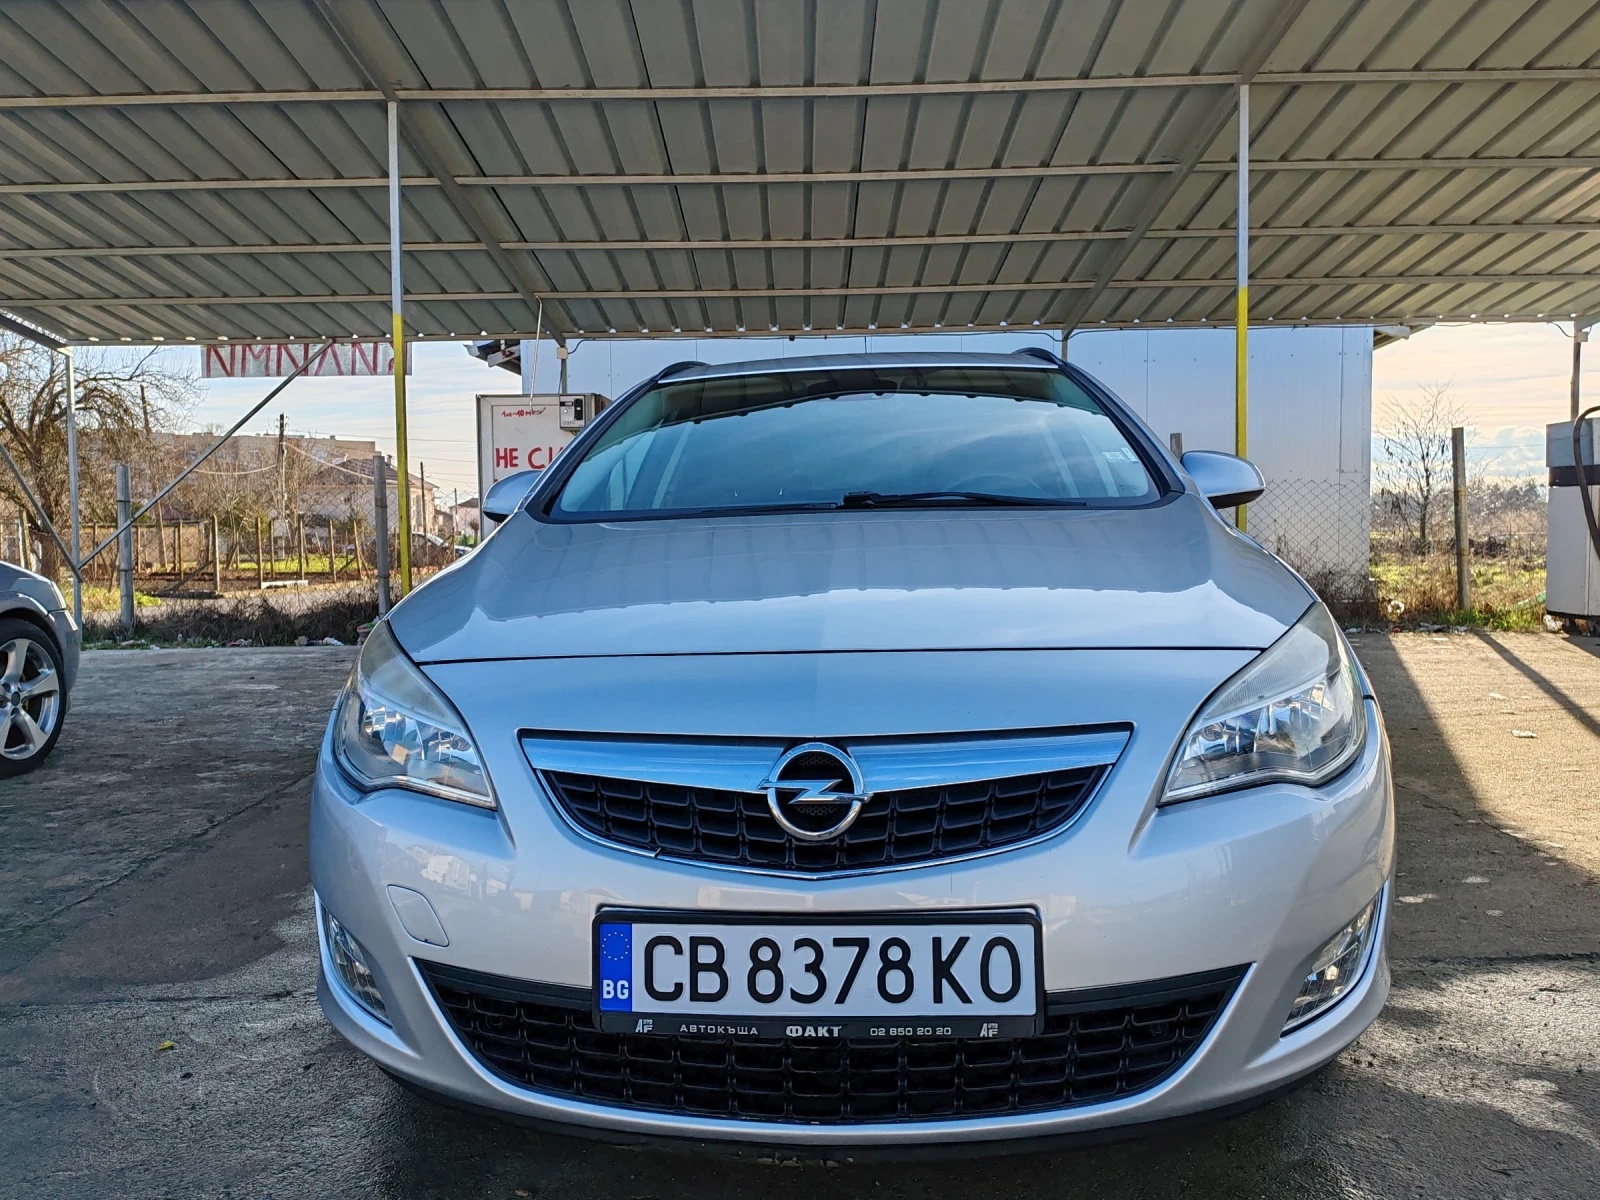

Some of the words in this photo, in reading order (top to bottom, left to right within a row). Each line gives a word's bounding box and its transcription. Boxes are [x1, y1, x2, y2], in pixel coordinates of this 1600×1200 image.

[495, 447, 519, 469] НЕ
[644, 935, 729, 1003] CB
[747, 936, 914, 1004] 8378
[602, 979, 629, 1000] BG
[785, 1025, 842, 1037] ФАКТ
[870, 1027, 886, 1036] 02
[889, 1027, 913, 1036] 850
[916, 1027, 932, 1036] 20
[935, 1027, 952, 1036] 20
